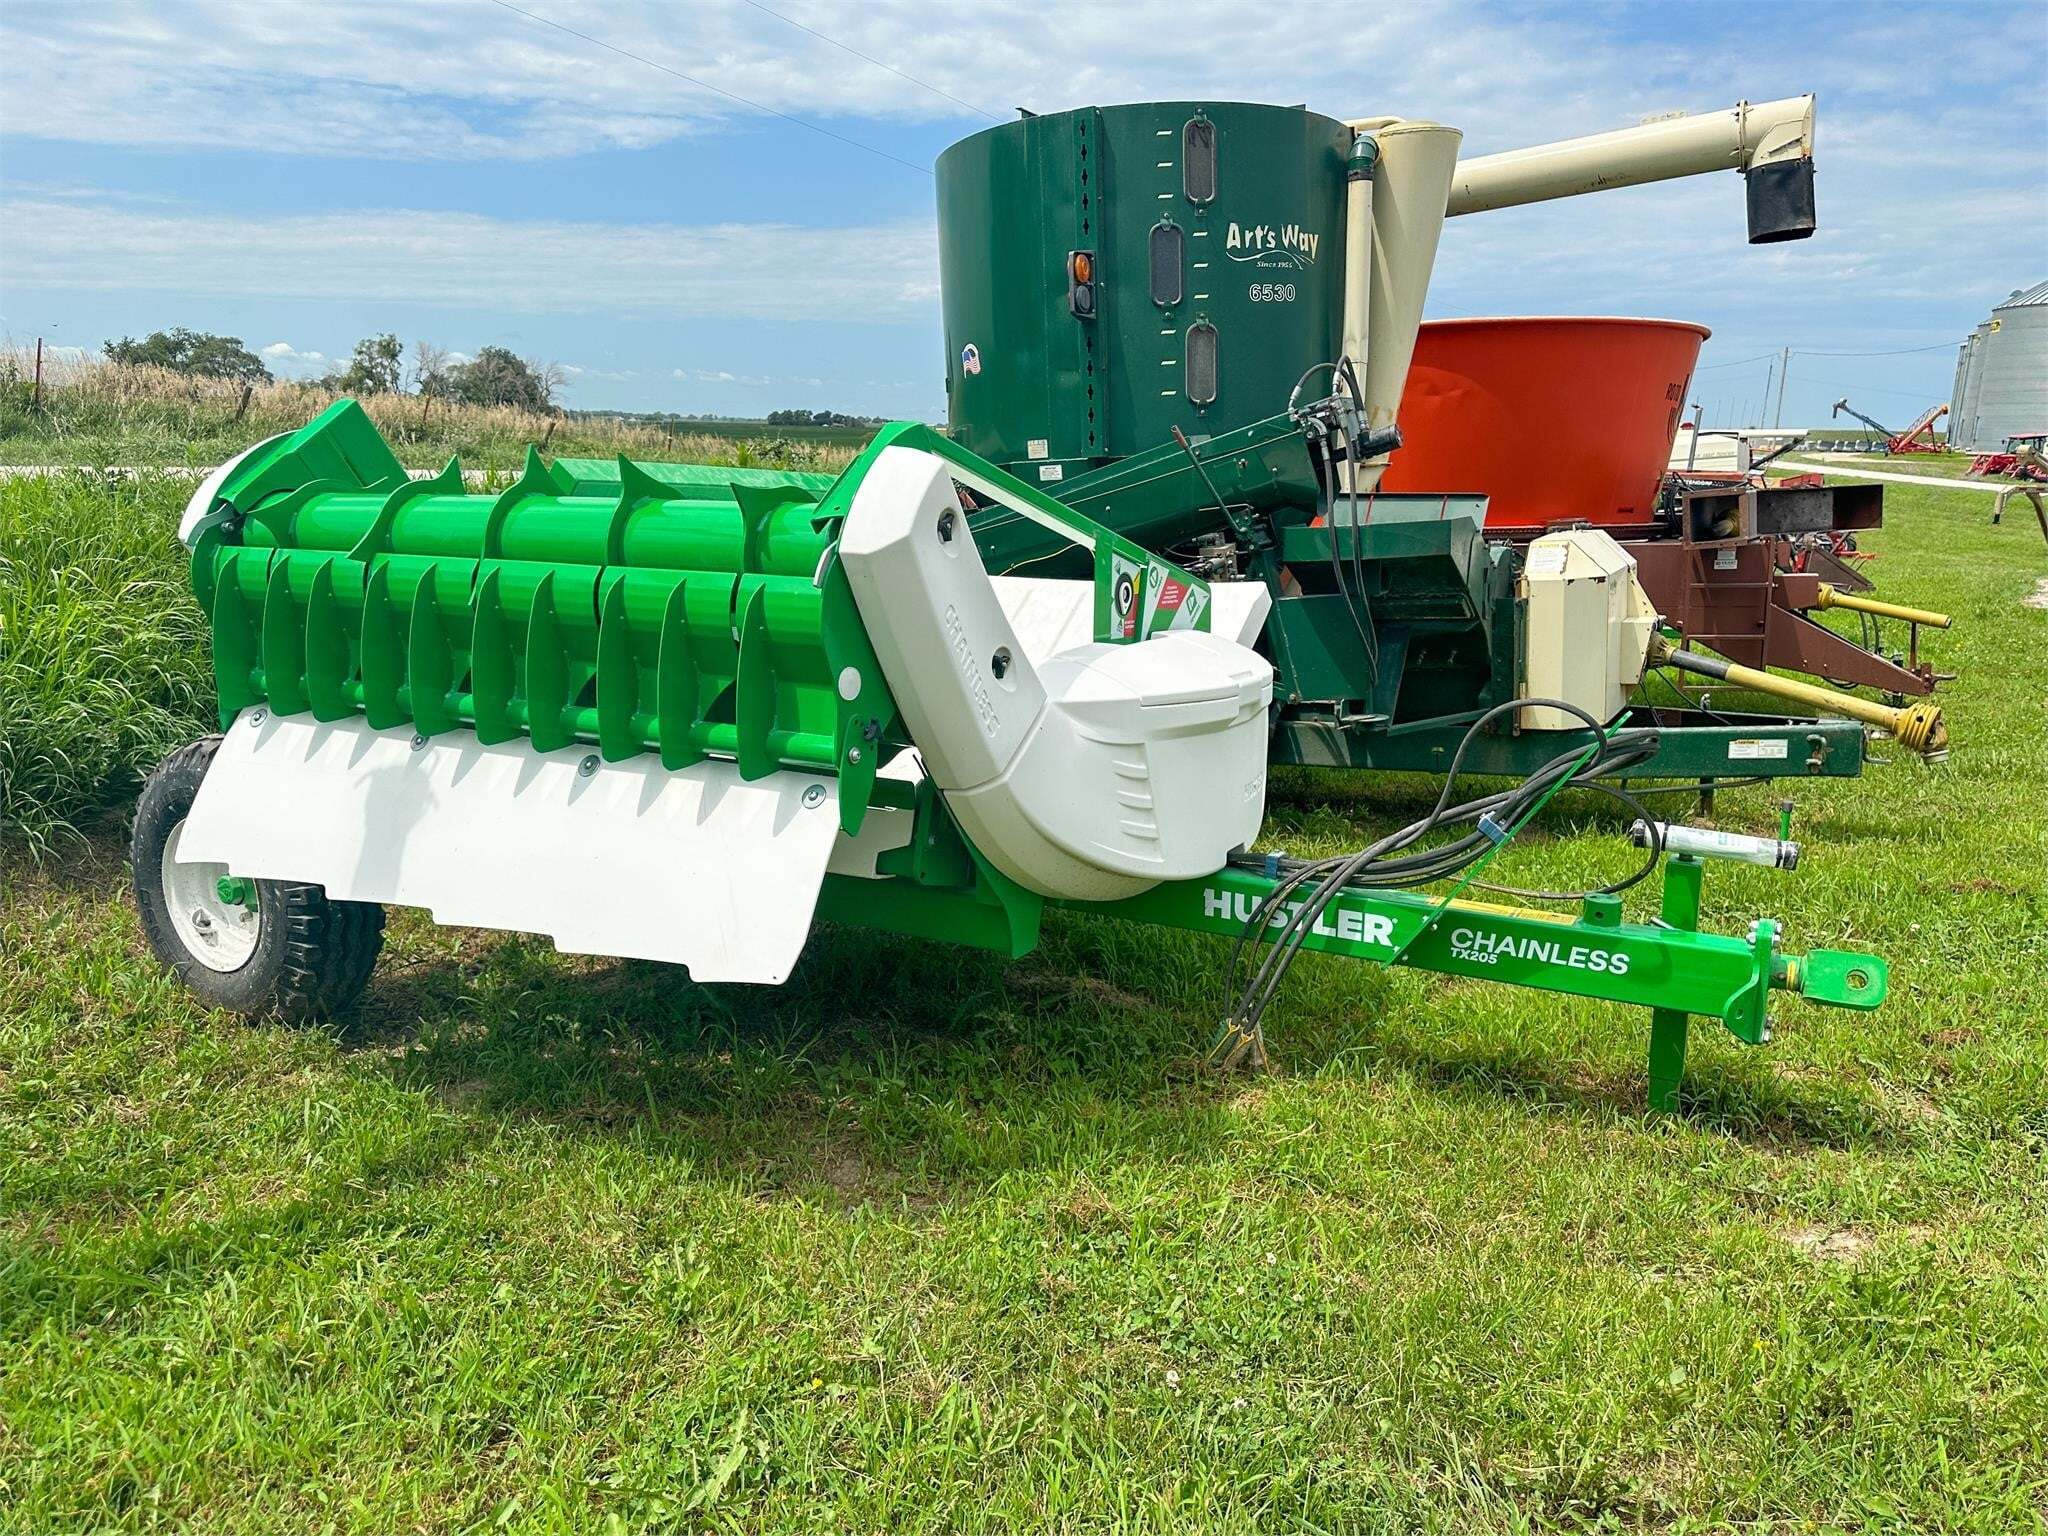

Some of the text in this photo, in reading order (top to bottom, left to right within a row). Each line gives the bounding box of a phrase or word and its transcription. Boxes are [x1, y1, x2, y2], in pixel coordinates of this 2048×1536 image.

[1226, 222, 1319, 259] Art's Way
[1255, 260, 1277, 268] Since
[1249, 284, 1295, 301] 6530
[945, 603, 1001, 738] CHAINLESS
[1450, 928, 1630, 975] CHAINLESS
[1450, 947, 1498, 965] TX205
